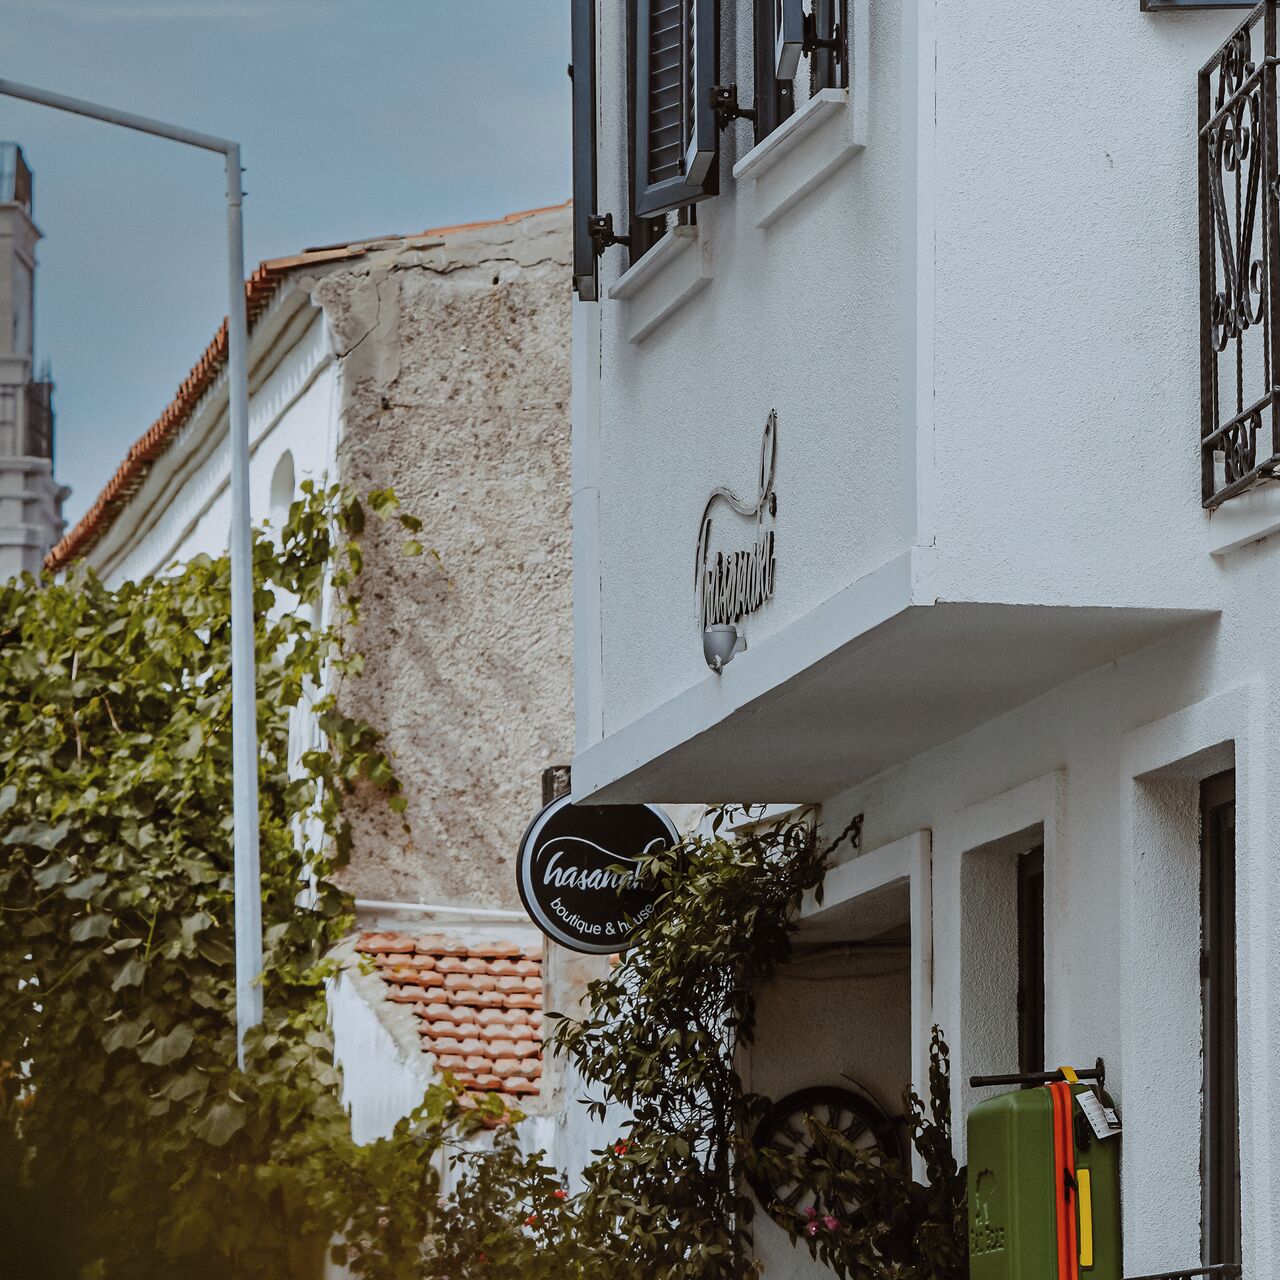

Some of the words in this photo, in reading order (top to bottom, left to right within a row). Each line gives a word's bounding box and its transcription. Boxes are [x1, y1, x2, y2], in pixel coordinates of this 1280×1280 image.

[536, 836, 665, 890] hasana
[550, 897, 601, 935] boutique
[605, 922, 616, 935] &
